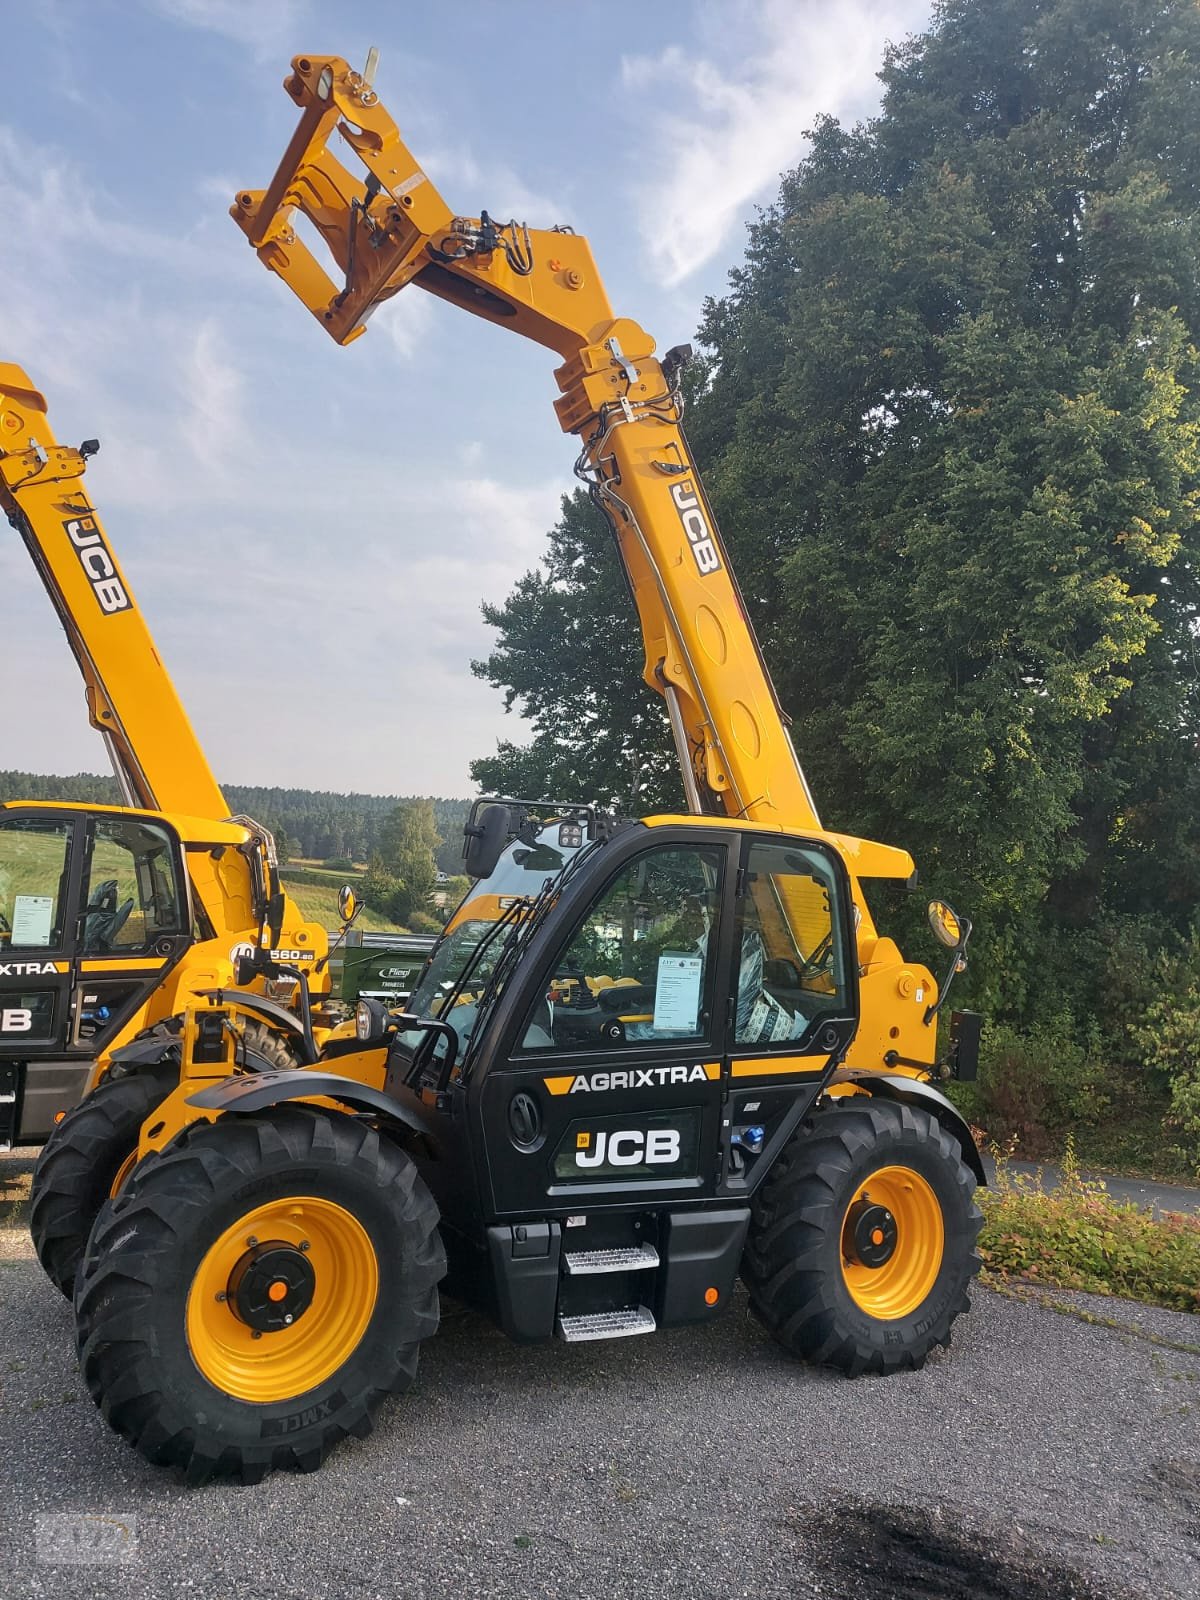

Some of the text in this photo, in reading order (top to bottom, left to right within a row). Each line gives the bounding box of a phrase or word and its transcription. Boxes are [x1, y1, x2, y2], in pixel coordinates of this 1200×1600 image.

[672, 484, 719, 573] JCB
[67, 521, 128, 612] JCB
[570, 1065, 708, 1094] AGRIXTRA
[575, 1129, 681, 1168] JCB
